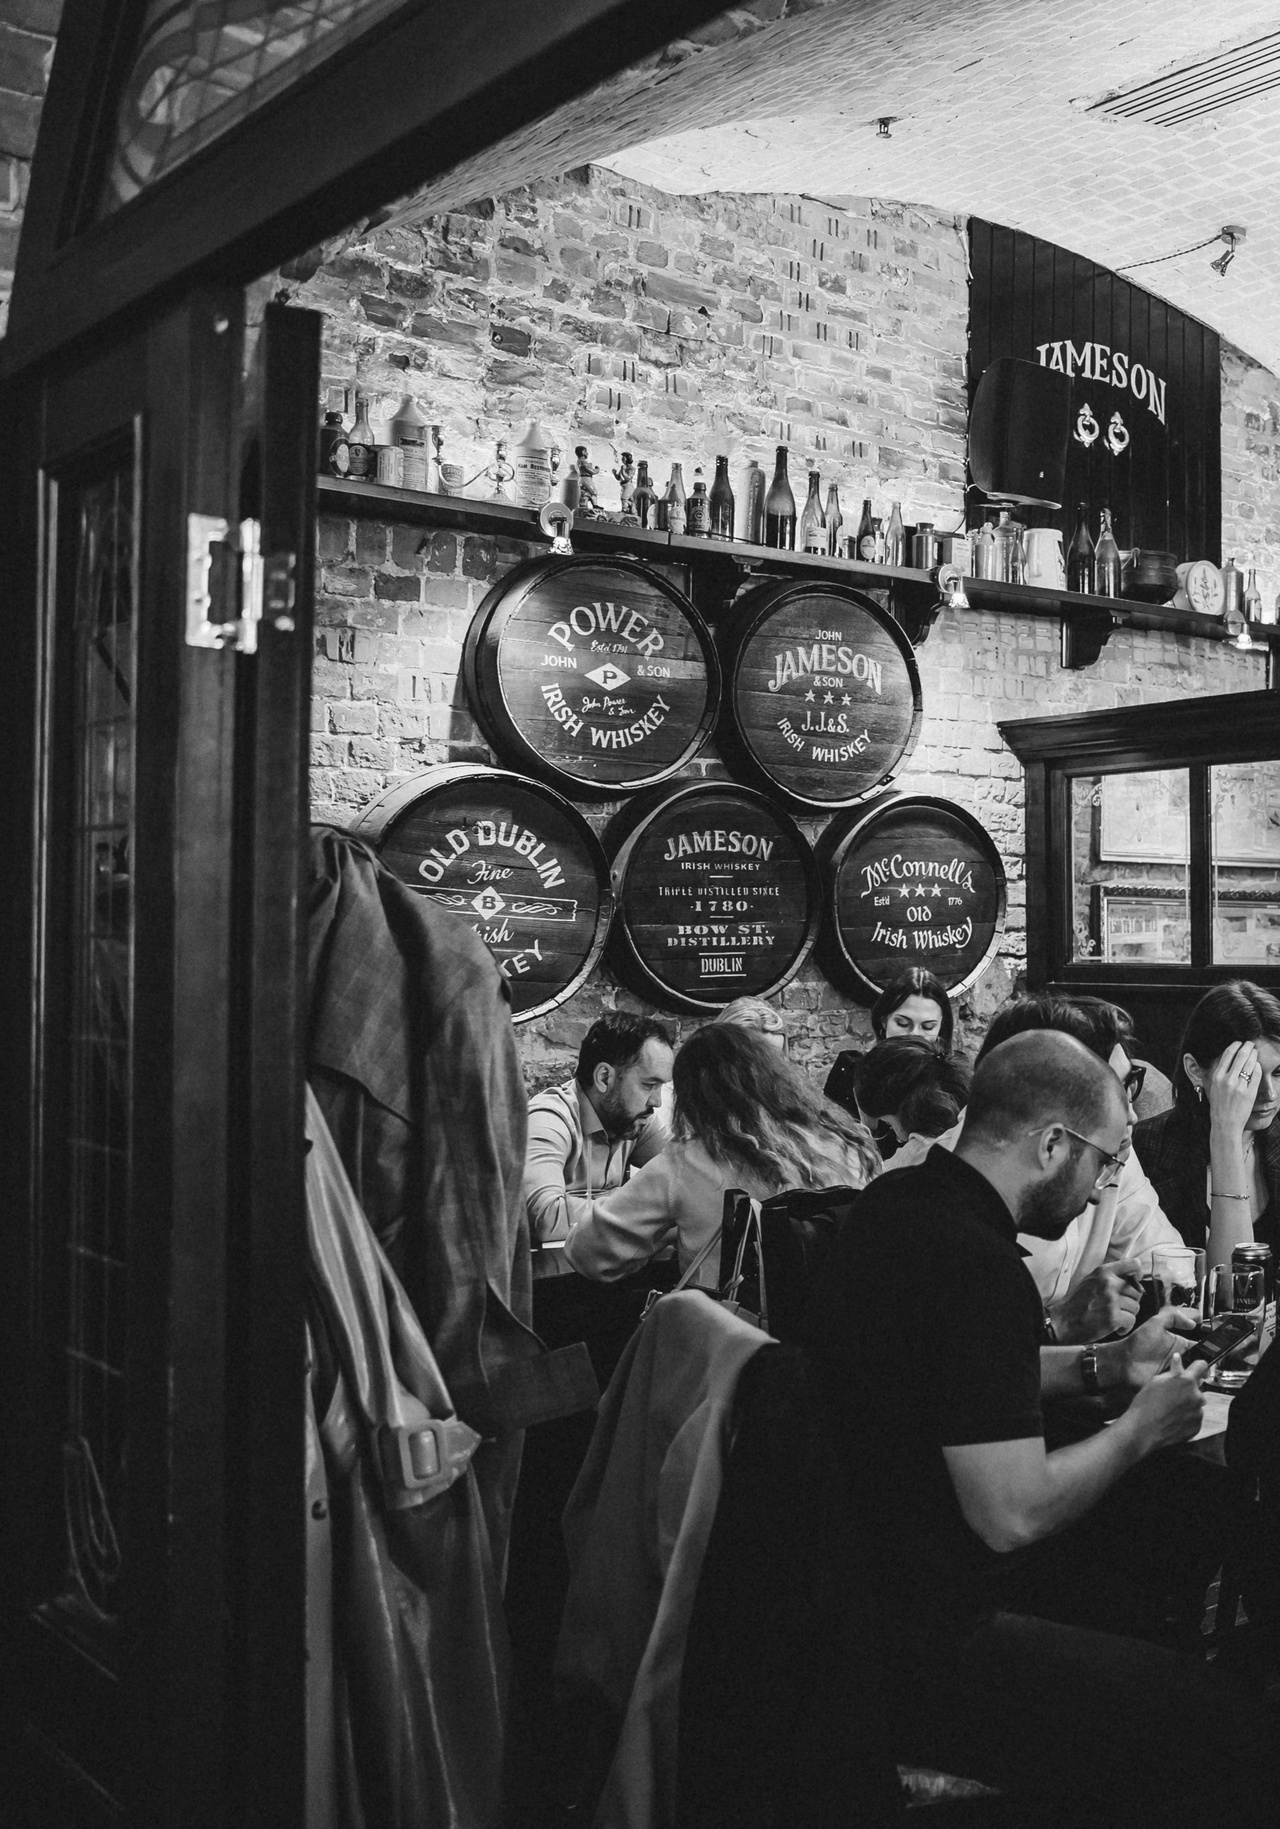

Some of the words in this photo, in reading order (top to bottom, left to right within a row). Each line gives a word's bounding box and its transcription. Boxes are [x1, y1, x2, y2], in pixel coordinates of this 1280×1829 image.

[547, 602, 665, 661] POWER
[815, 629, 842, 642] JOHN
[541, 654, 577, 669] JOHN
[637, 664, 645, 676] &
[647, 665, 671, 678] SON
[767, 643, 883, 696] JAMESON
[602, 670, 617, 684] P
[813, 675, 821, 687] &
[822, 676, 844, 688] SON
[581, 696, 602, 713] John
[608, 706, 615, 716] &
[540, 682, 585, 738] IRISH
[590, 693, 671, 749] WHISKEY
[777, 717, 805, 752] IRISH
[812, 728, 872, 763] WHISKEY
[664, 830, 774, 862] JAMESON
[418, 828, 471, 883] OLD
[477, 820, 566, 890] DUBLIN
[466, 859, 514, 885] Fine
[681, 862, 711, 870] IRISH
[714, 863, 761, 871] WHISKEY
[658, 886, 693, 896] TRIPLE
[697, 886, 749, 896] DISTILLED
[752, 886, 780, 896] SINCE
[481, 895, 497, 910] B
[947, 896, 963, 906] 1776
[906, 904, 932, 923] Old
[471, 917, 515, 944] ish
[677, 924, 729, 935] BOW
[738, 924, 769, 935] ST.
[870, 921, 908, 949] Irish
[911, 916, 973, 950] Whiskey
[666, 935, 775, 947] DISTILLERY
[701, 957, 743, 973] DUBLIN
